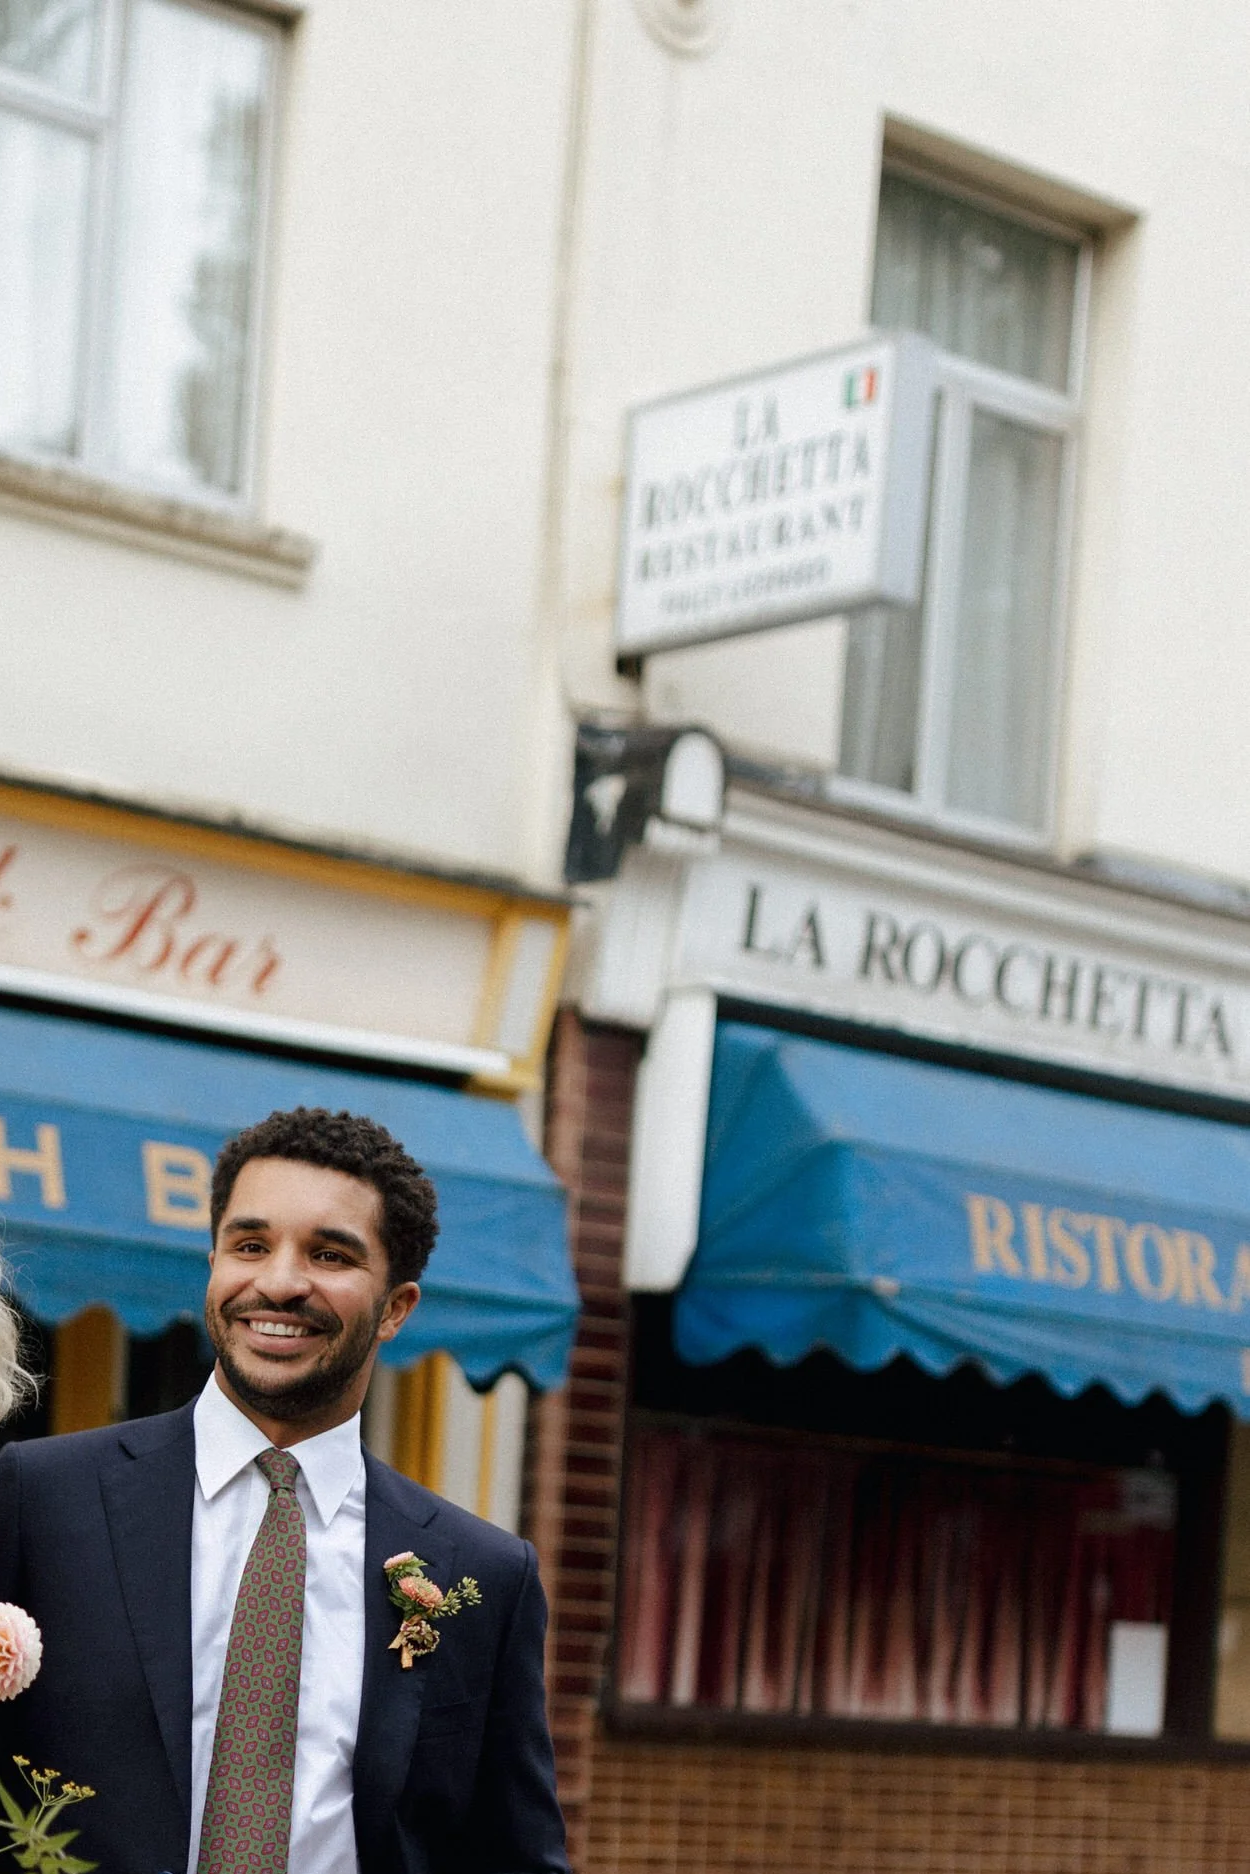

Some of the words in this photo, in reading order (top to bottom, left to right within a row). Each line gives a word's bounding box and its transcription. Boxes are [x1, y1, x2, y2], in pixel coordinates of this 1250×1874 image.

[733, 392, 780, 451] LA
[72, 858, 287, 996] Bar
[739, 880, 829, 970] LA
[857, 909, 1235, 1059] ROCCHETTA
